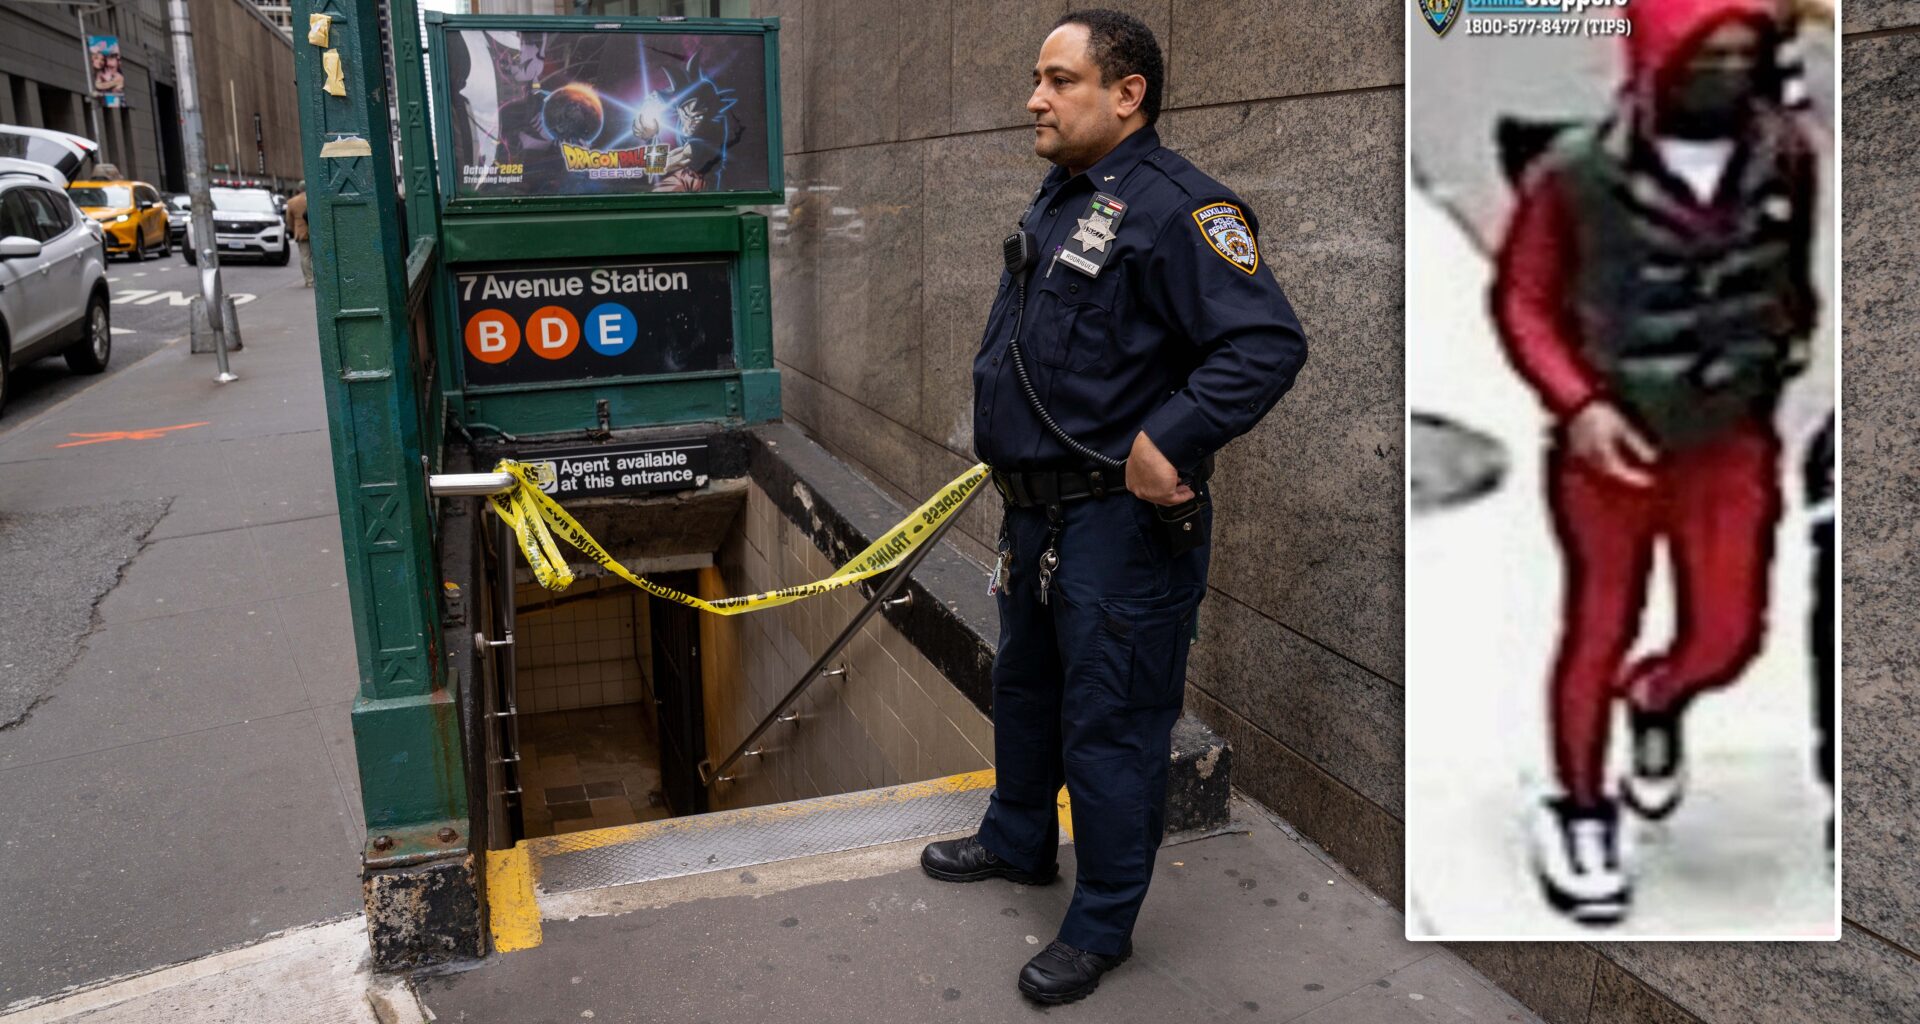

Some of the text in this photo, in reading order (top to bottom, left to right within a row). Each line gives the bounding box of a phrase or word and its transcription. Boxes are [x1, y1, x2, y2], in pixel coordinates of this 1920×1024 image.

[562, 143, 619, 169] DRAGON
[619, 146, 647, 168] BALL
[463, 163, 524, 175] October 2026
[590, 168, 643, 179] BEERUS
[498, 175, 523, 184] begins!
[1199, 206, 1238, 220] AUXILIARY
[1065, 253, 1096, 272] RODRIGUEZ
[458, 268, 689, 301] 7 Avenue Station
[478, 313, 624, 353] B D E
[560, 456, 610, 477] Agent
[617, 450, 688, 470] available
[561, 469, 693, 491] at this entrance
